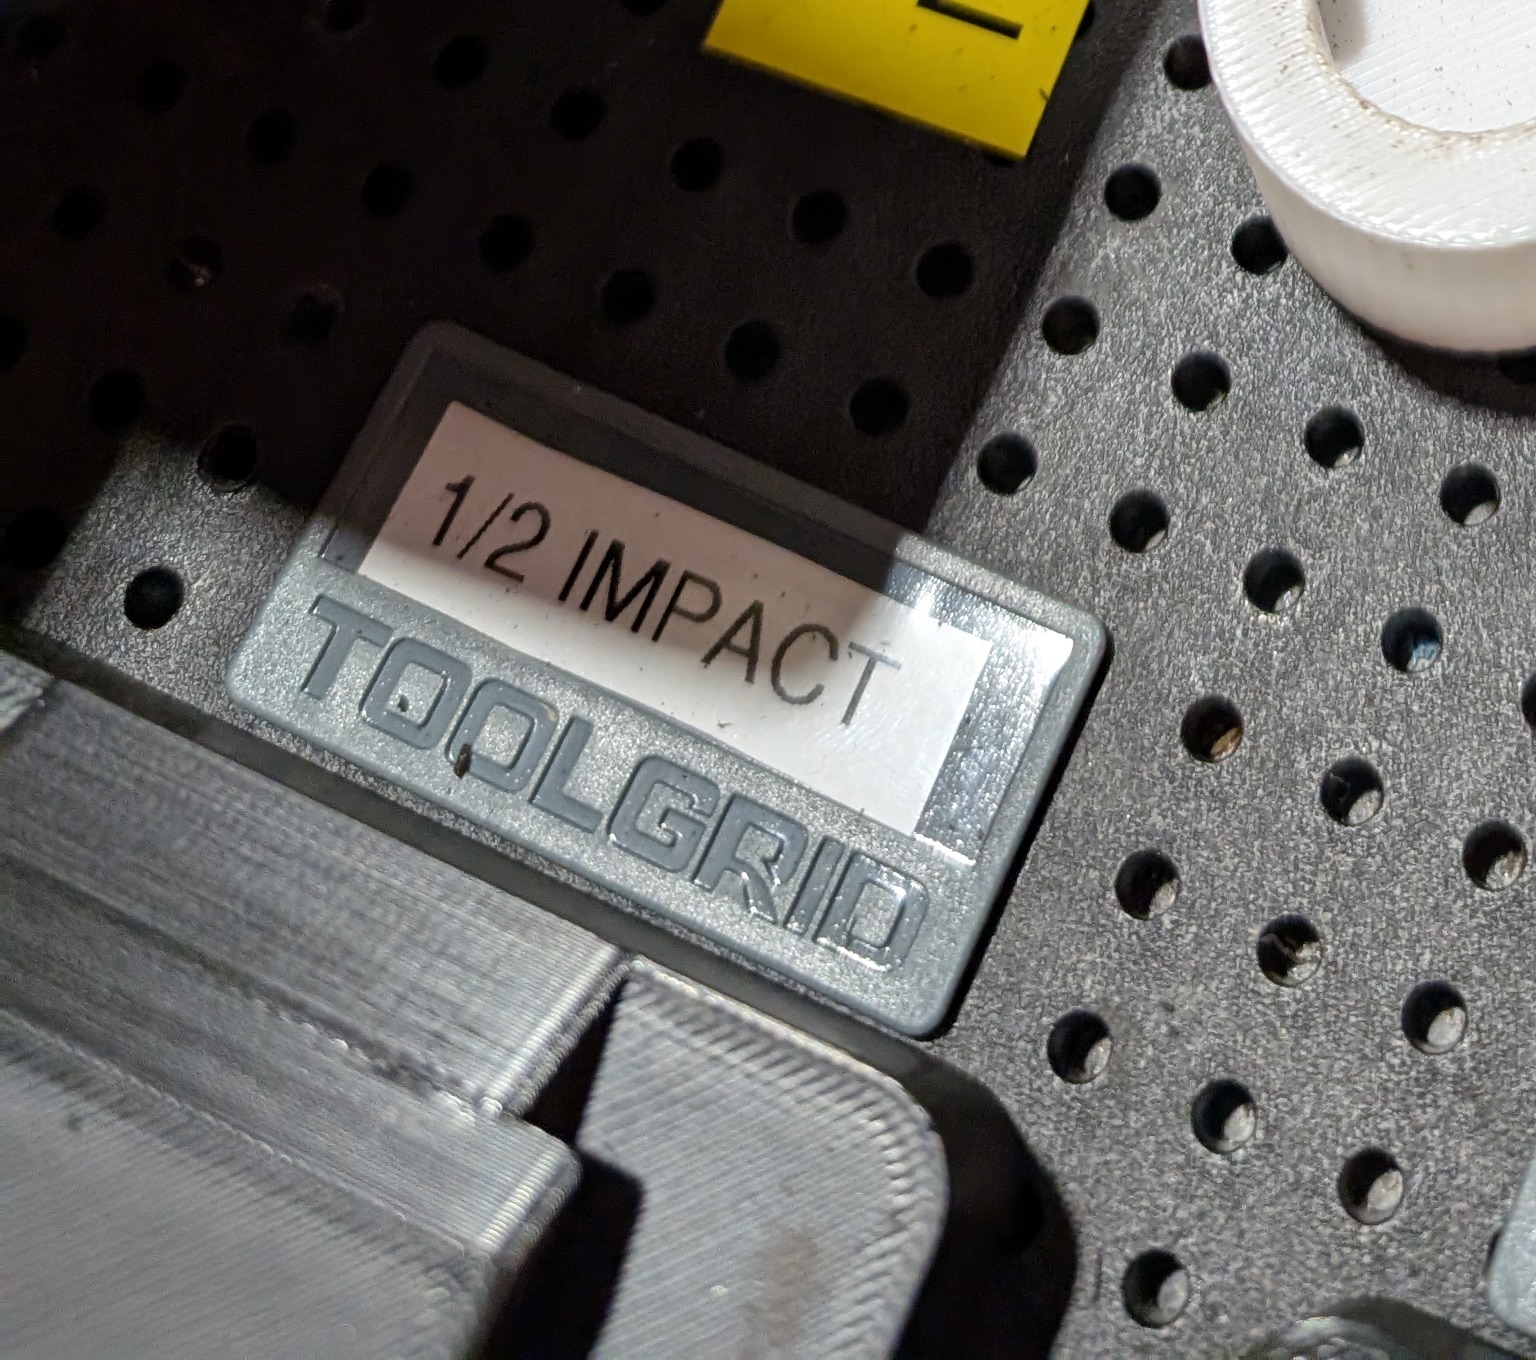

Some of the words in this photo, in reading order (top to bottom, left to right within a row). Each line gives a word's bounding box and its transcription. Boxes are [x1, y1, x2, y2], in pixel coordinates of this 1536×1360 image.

[431, 473, 552, 584] 1/2
[559, 528, 903, 726] IMPACT
[299, 594, 931, 975] TOOLGRID
